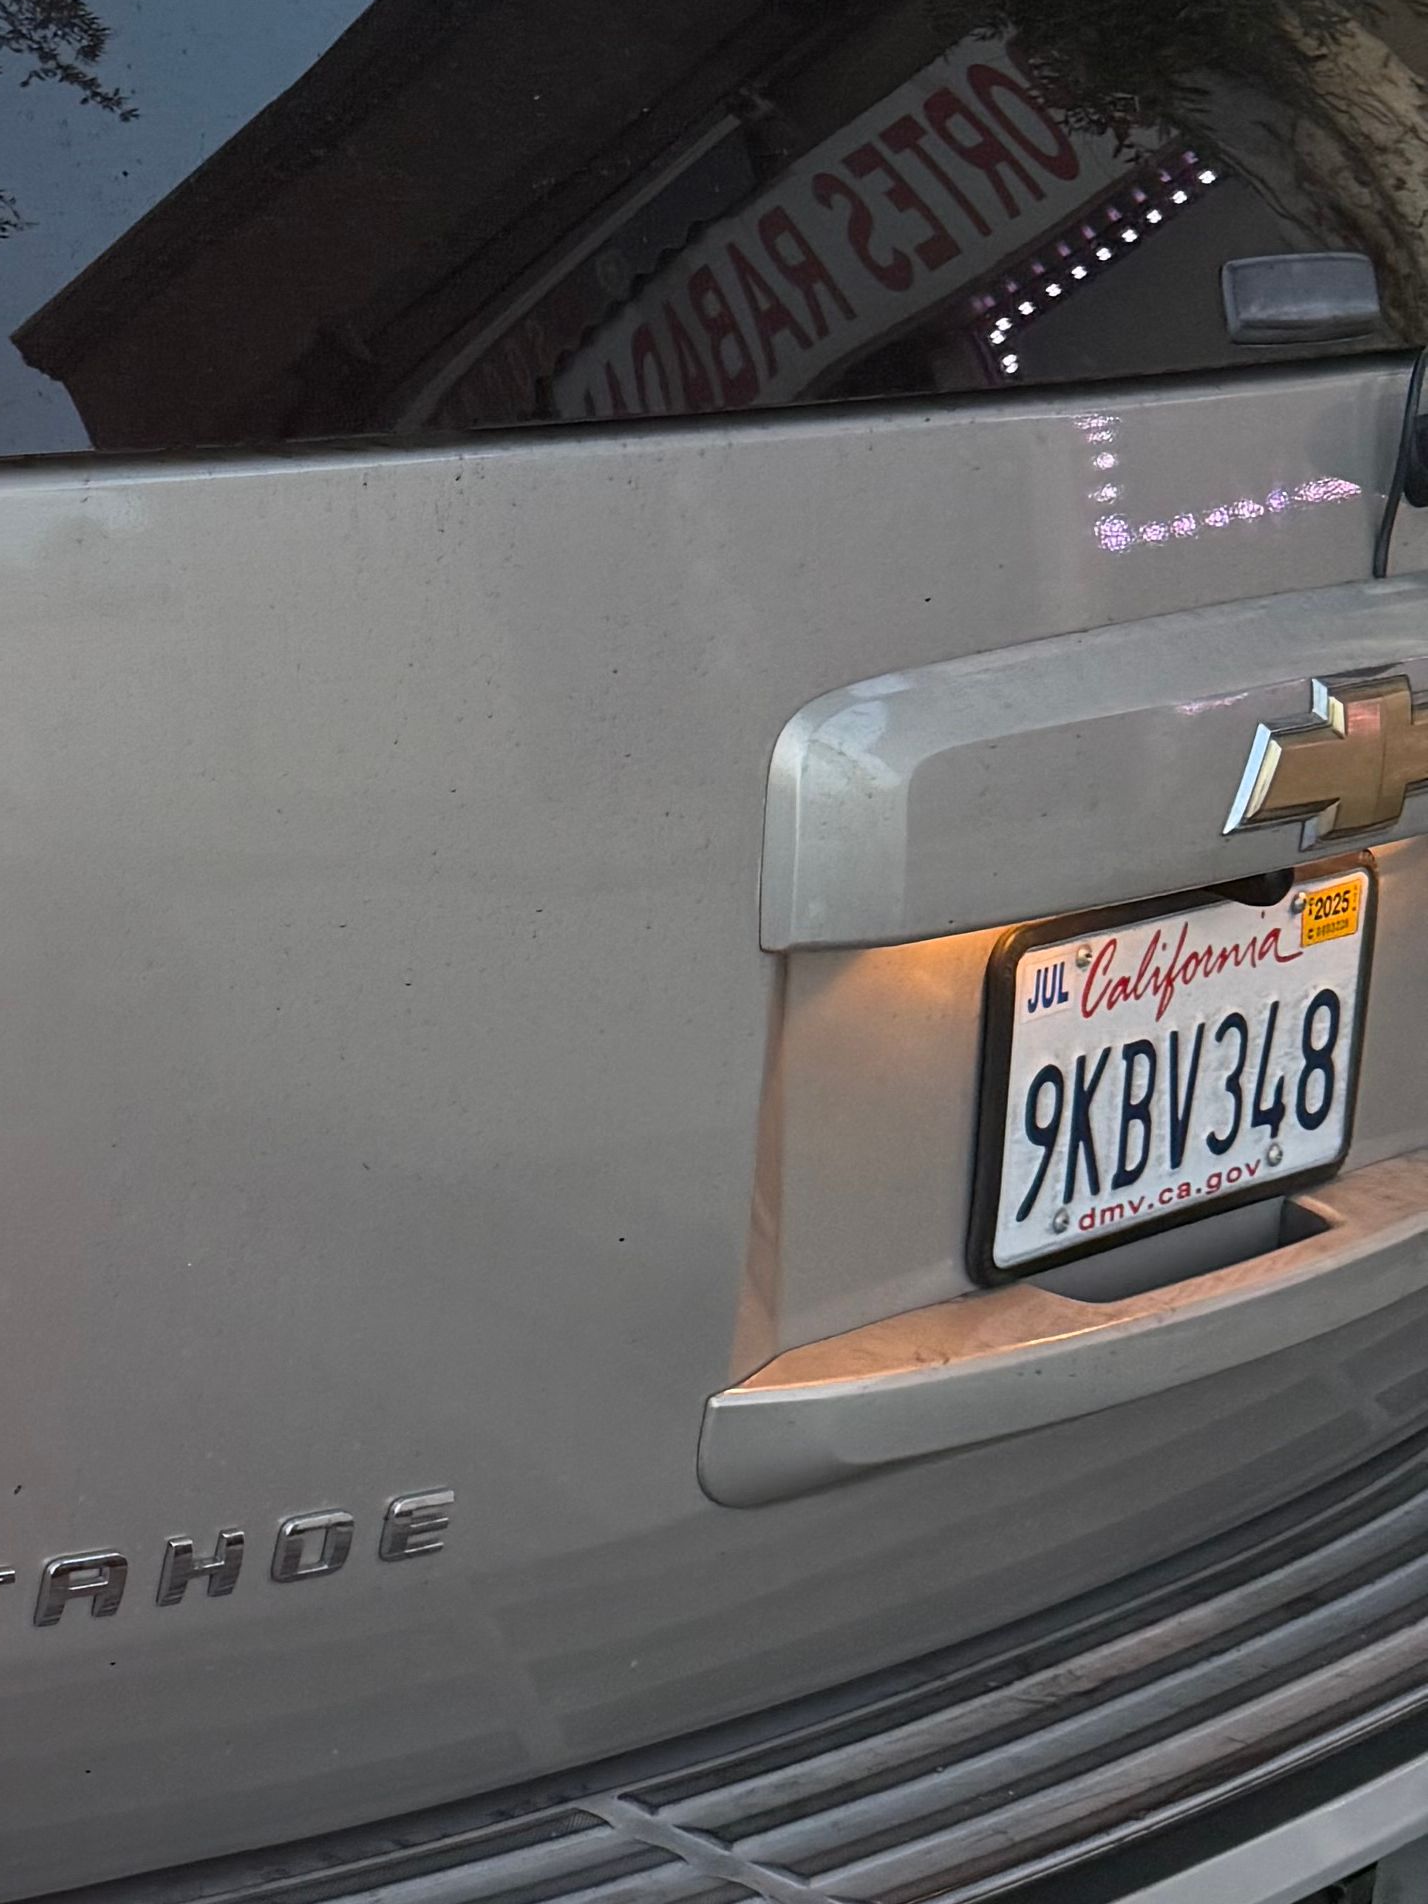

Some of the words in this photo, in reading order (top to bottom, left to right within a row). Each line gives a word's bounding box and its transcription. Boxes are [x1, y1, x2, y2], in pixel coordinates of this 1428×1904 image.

[1313, 890, 1352, 922] 2025
[1027, 960, 1070, 1014] JUL
[1081, 911, 1302, 1022] California
[1016, 988, 1341, 1224] 9KBV348
[1078, 1158, 1262, 1232] dmv.ca.gov
